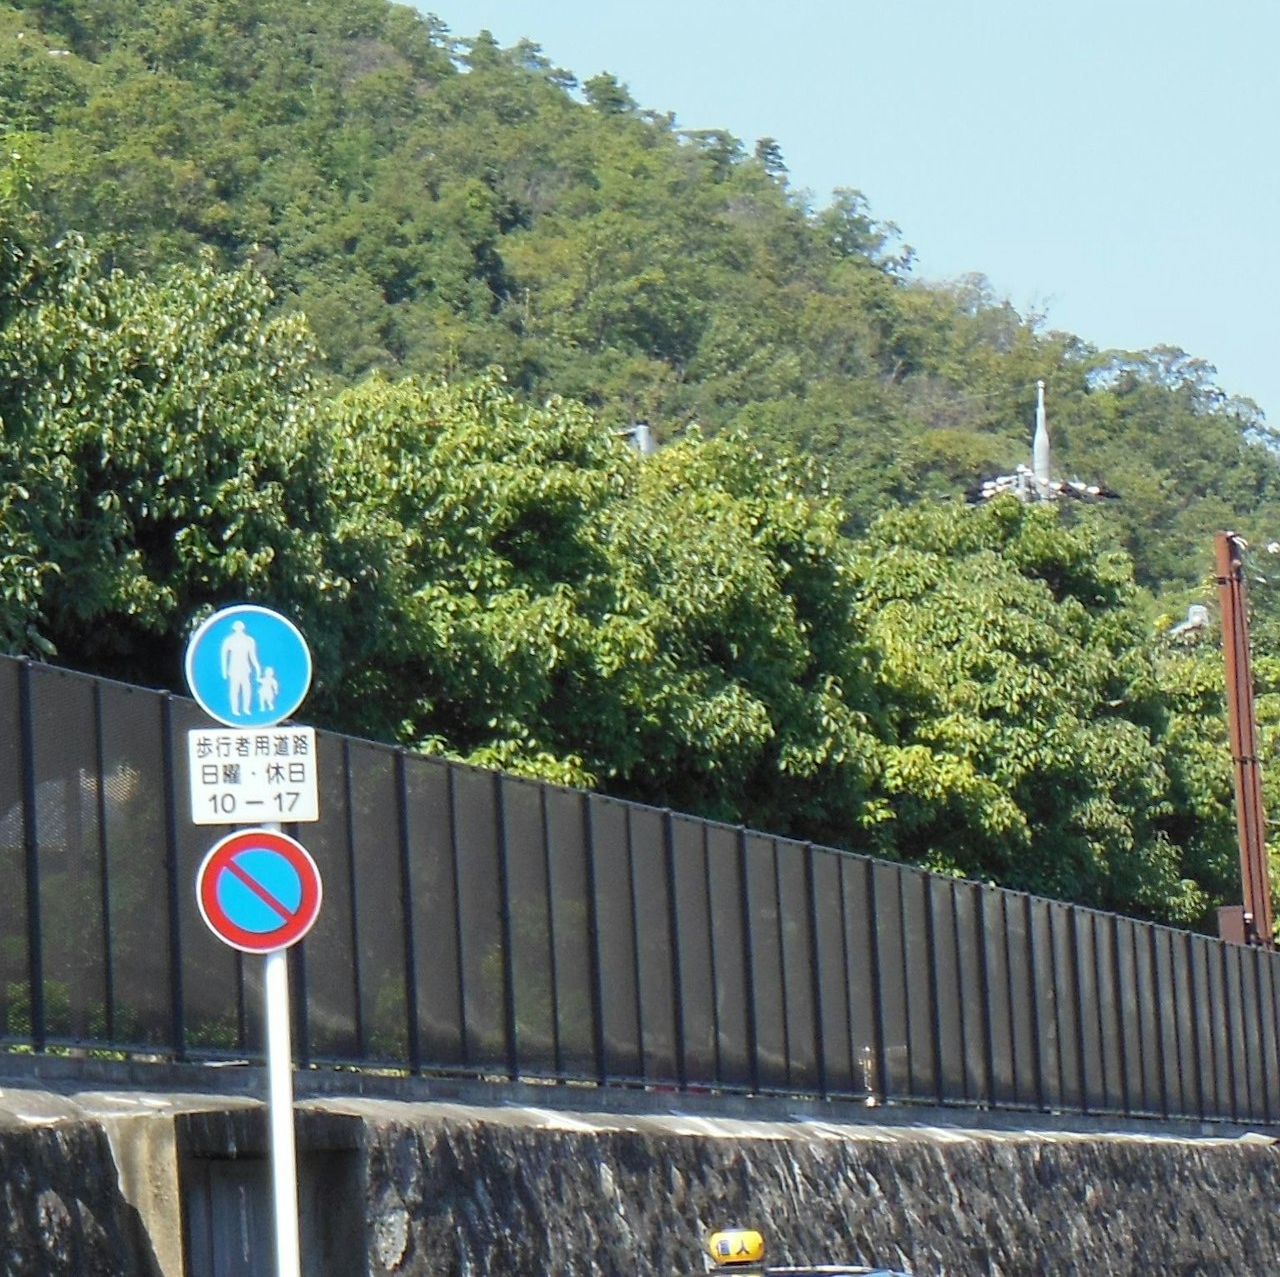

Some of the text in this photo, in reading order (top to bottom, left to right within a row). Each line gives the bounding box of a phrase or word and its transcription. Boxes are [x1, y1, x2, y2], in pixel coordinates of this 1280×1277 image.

[197, 734, 308, 758] 歩行者用道路
[201, 762, 305, 785] 日曜・休日
[716, 1239, 751, 1257] 個人
